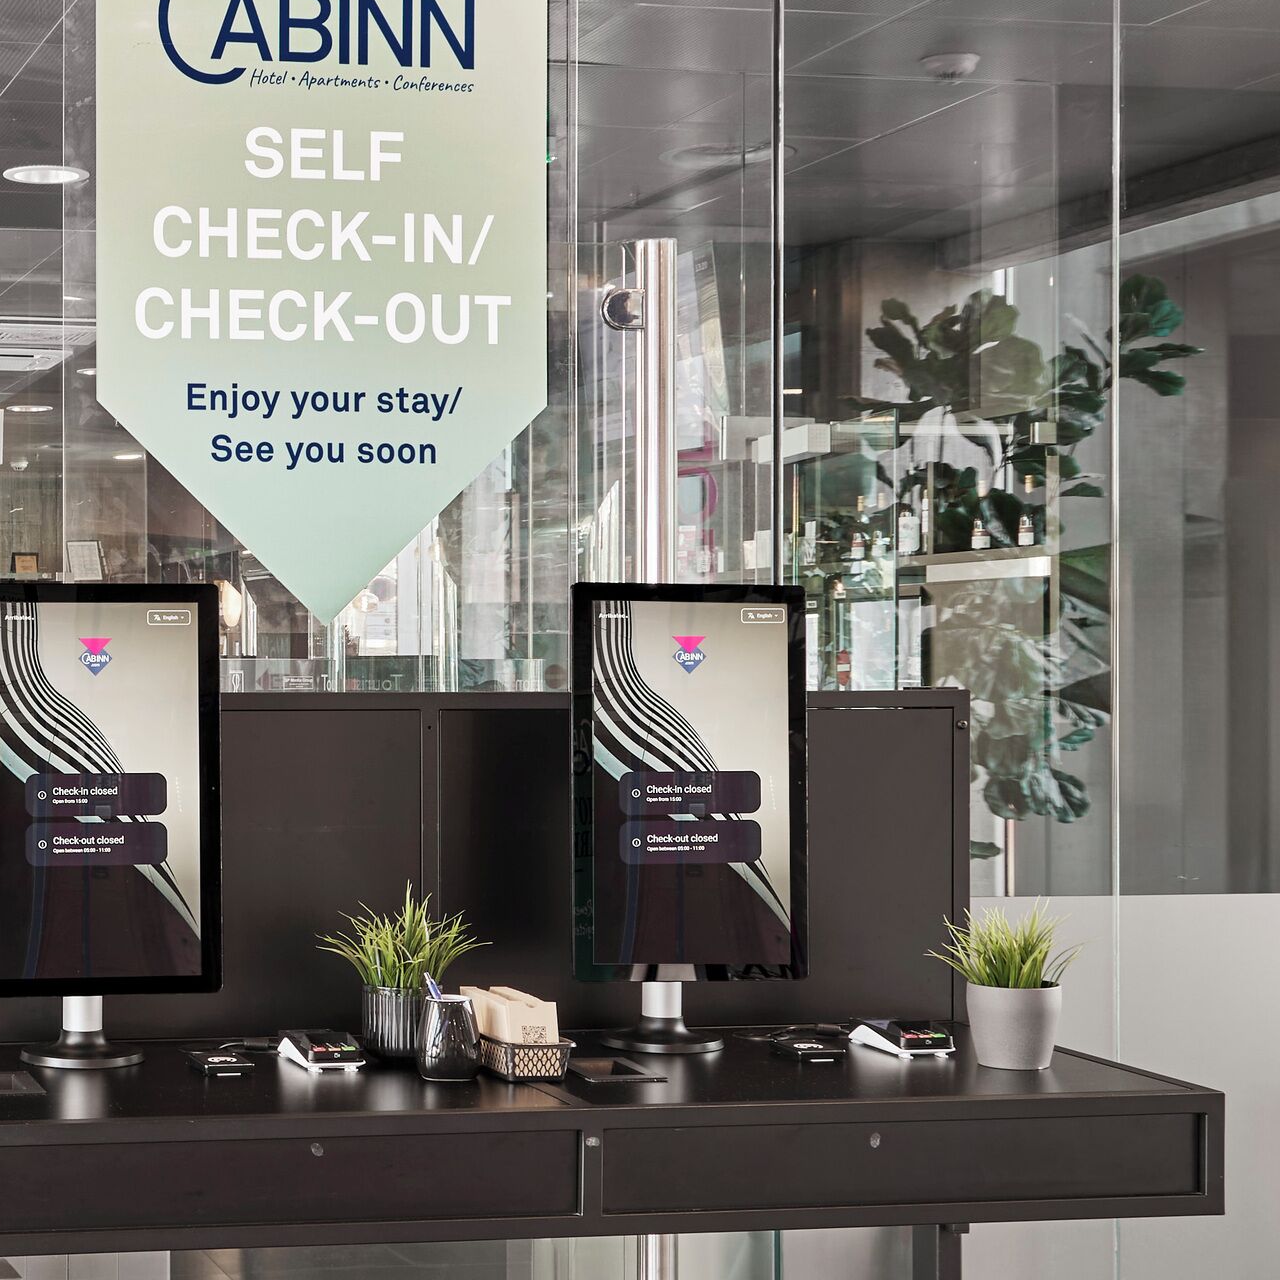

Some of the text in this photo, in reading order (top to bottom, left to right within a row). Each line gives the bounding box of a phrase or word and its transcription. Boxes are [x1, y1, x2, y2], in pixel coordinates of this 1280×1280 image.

[250, 67, 474, 94] Hotel Apartments Conferences
[244, 125, 404, 182] SELF
[152, 205, 494, 265] CHECK-IN/
[134, 287, 512, 345] CHECK-OUT
[186, 382, 462, 422] Enjoy your stay/
[210, 433, 436, 470] See you soon
[81, 653, 110, 665] CABINN
[675, 651, 704, 663] CABINN
[52, 786, 118, 796] Check-in closed
[646, 784, 712, 794] Check-in closed
[53, 835, 125, 846] Check-out closed
[647, 833, 719, 843] Check-out closed
